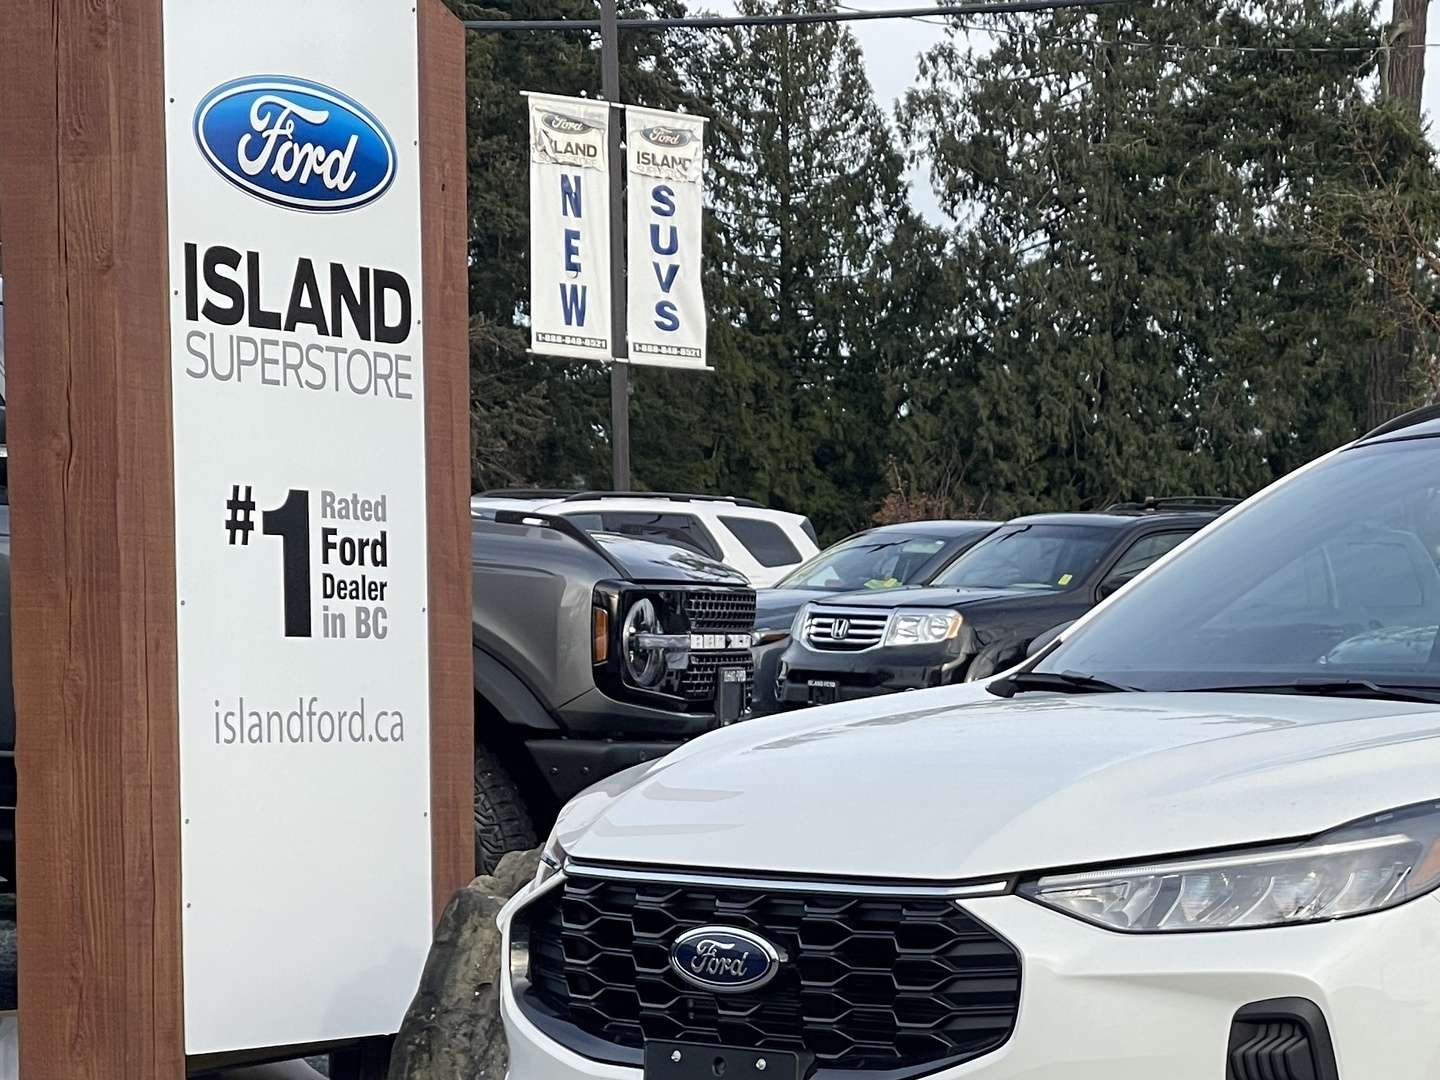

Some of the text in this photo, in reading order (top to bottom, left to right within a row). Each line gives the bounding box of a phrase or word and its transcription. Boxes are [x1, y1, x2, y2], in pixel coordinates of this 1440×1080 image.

[551, 114, 584, 131] Ford
[649, 127, 681, 145] Ford
[236, 94, 358, 193] Ford
[550, 140, 597, 158] LAND
[560, 174, 587, 327] NEW
[650, 185, 680, 332] SUVS
[185, 243, 411, 344] ISLAND
[186, 331, 413, 400] SUPERSTORE
[321, 491, 387, 523] Rated
[225, 485, 311, 638] #1
[322, 528, 388, 568] Ford
[322, 572, 388, 602] Dealer
[322, 605, 388, 640] in BC
[214, 697, 405, 744] islandford.ca
[691, 939, 749, 976] Ford
